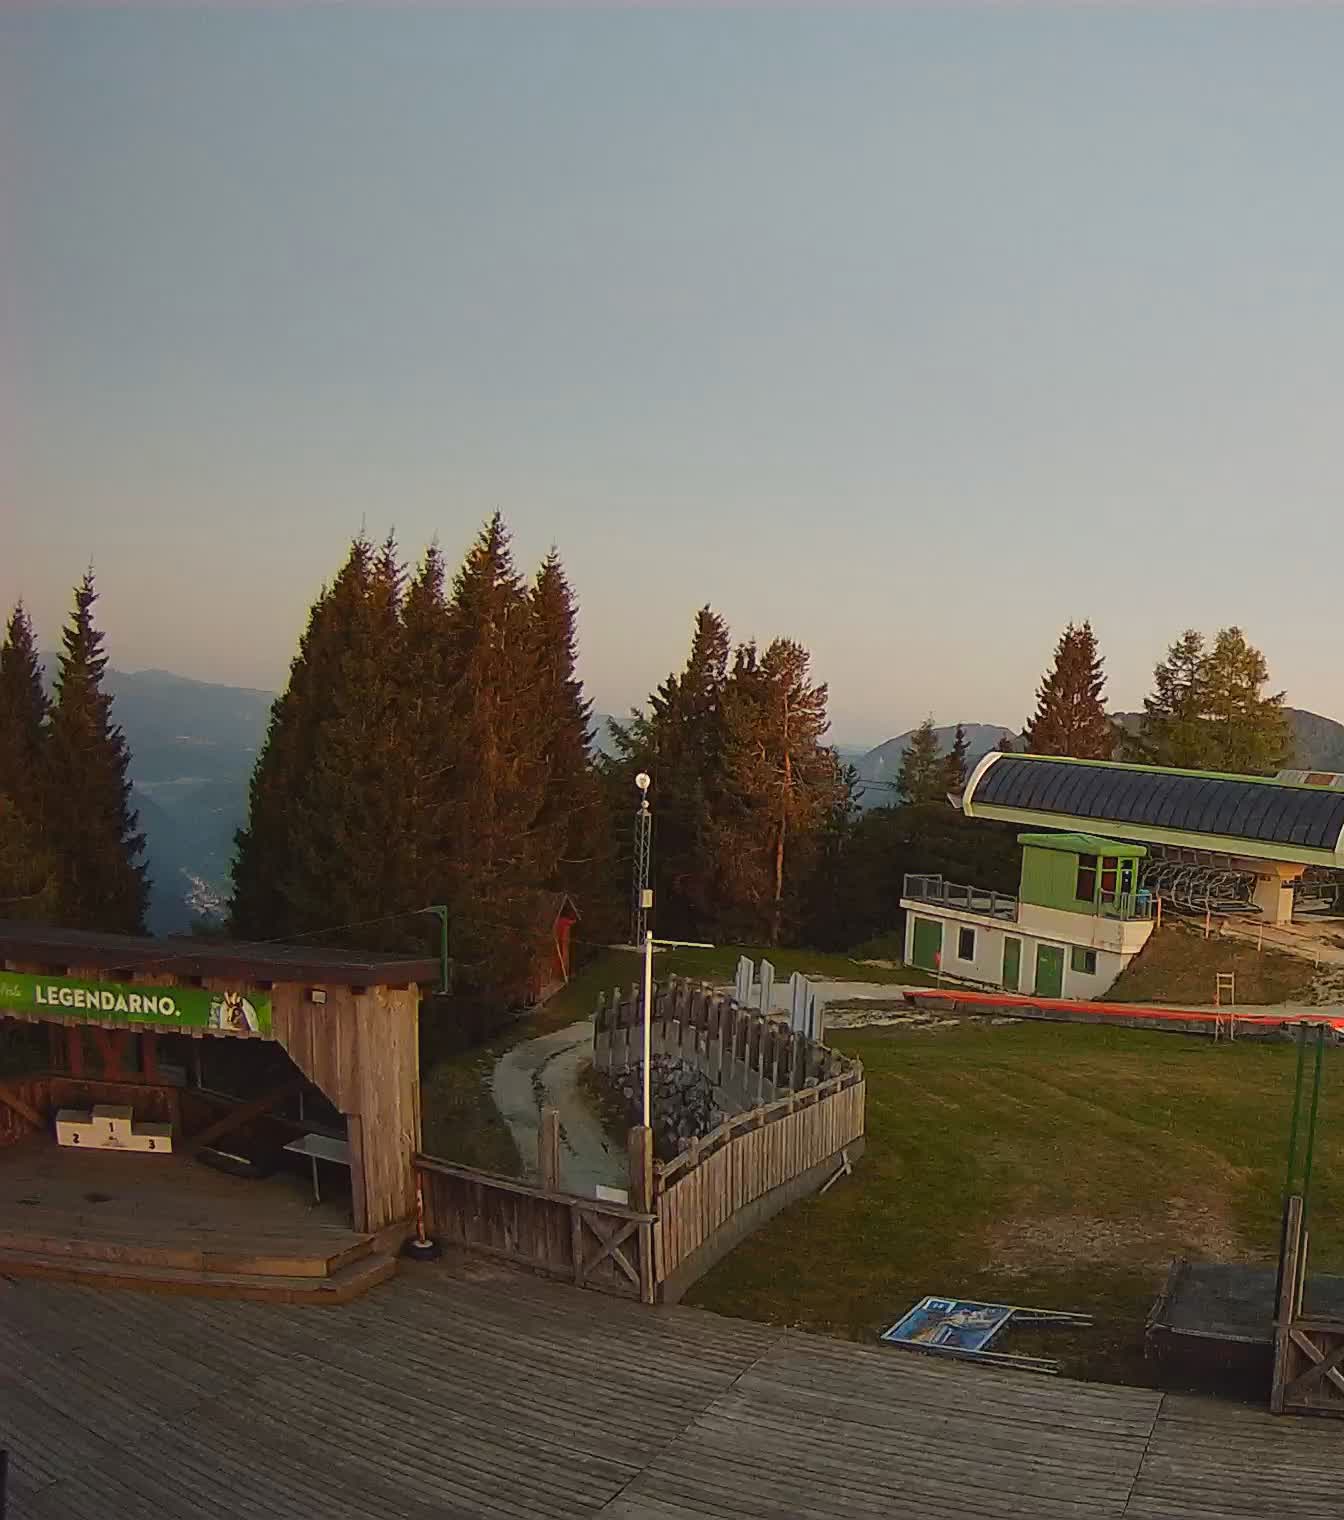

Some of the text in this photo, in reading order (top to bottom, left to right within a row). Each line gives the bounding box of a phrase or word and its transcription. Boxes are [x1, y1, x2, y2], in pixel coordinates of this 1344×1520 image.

[35, 984, 182, 1017] LEGENDARNO.
[108, 1122, 115, 1132] 1
[72, 1133, 80, 1144] 2
[148, 1139, 156, 1150] 3
